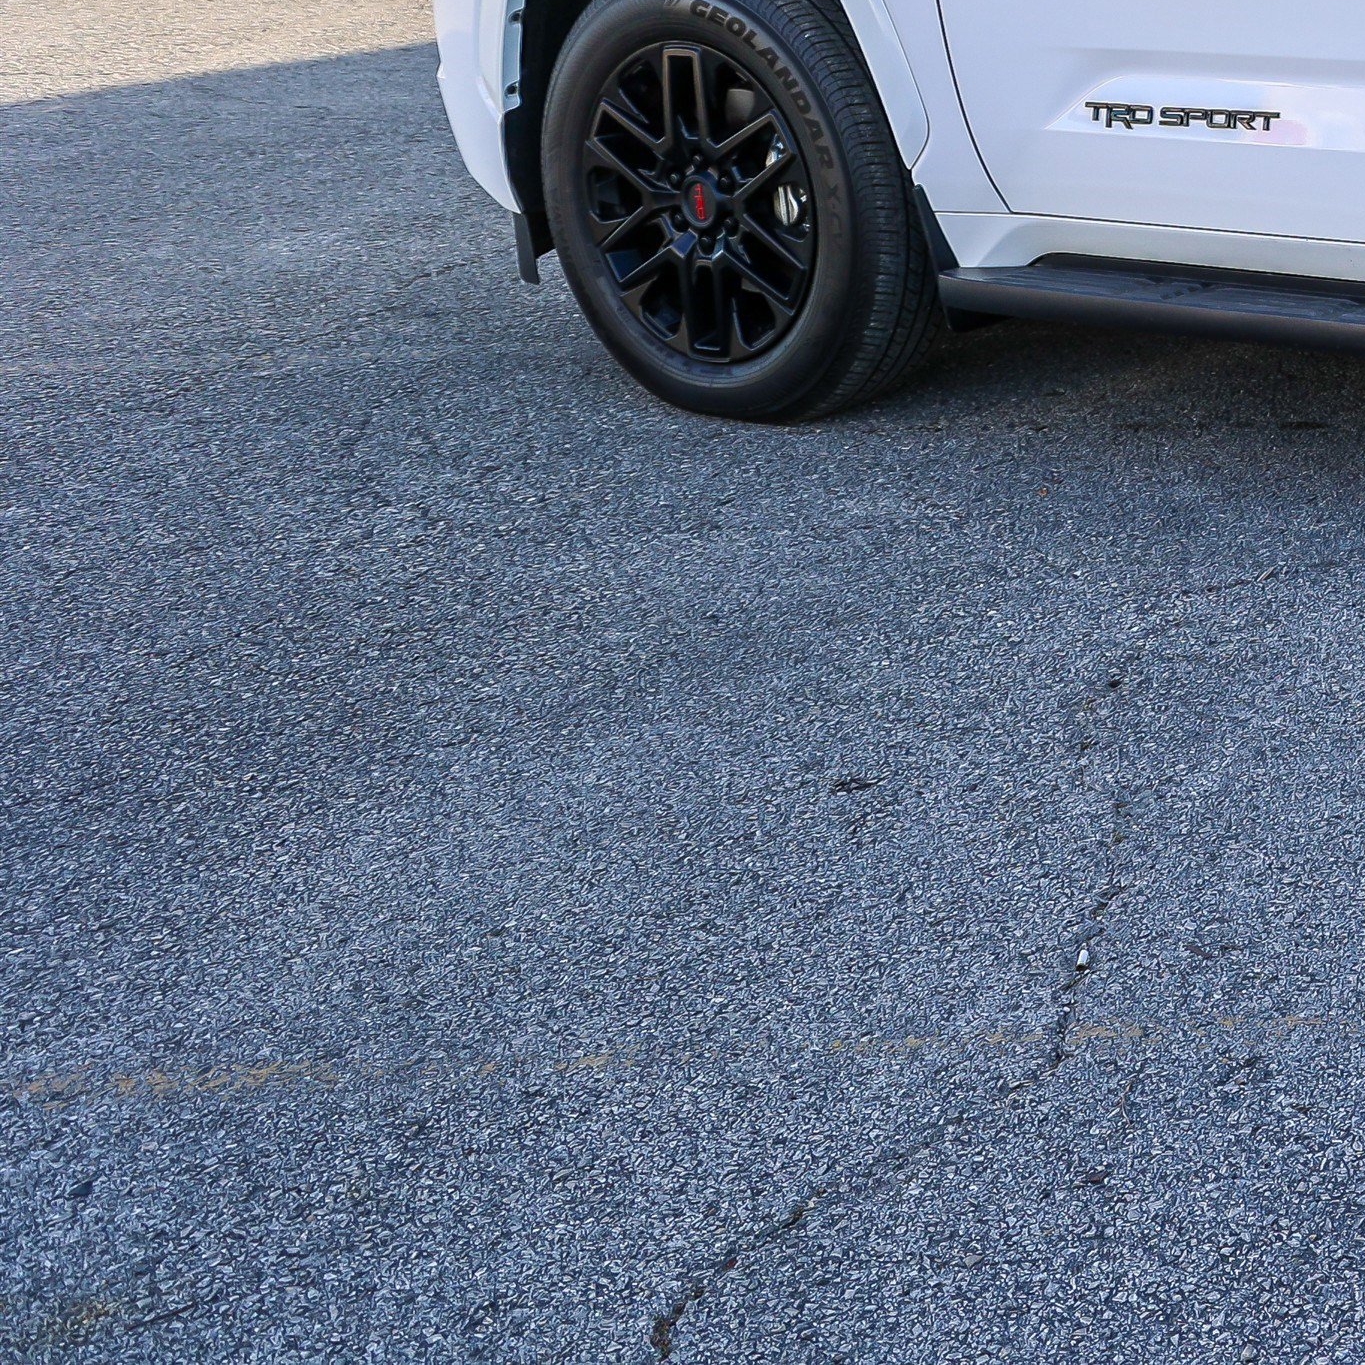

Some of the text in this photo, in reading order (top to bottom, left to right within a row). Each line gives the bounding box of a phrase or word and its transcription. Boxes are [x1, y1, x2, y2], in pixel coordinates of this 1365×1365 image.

[689, 0, 835, 170] GEOLANDAR
[1084, 101, 1281, 131] TRD SPORT
